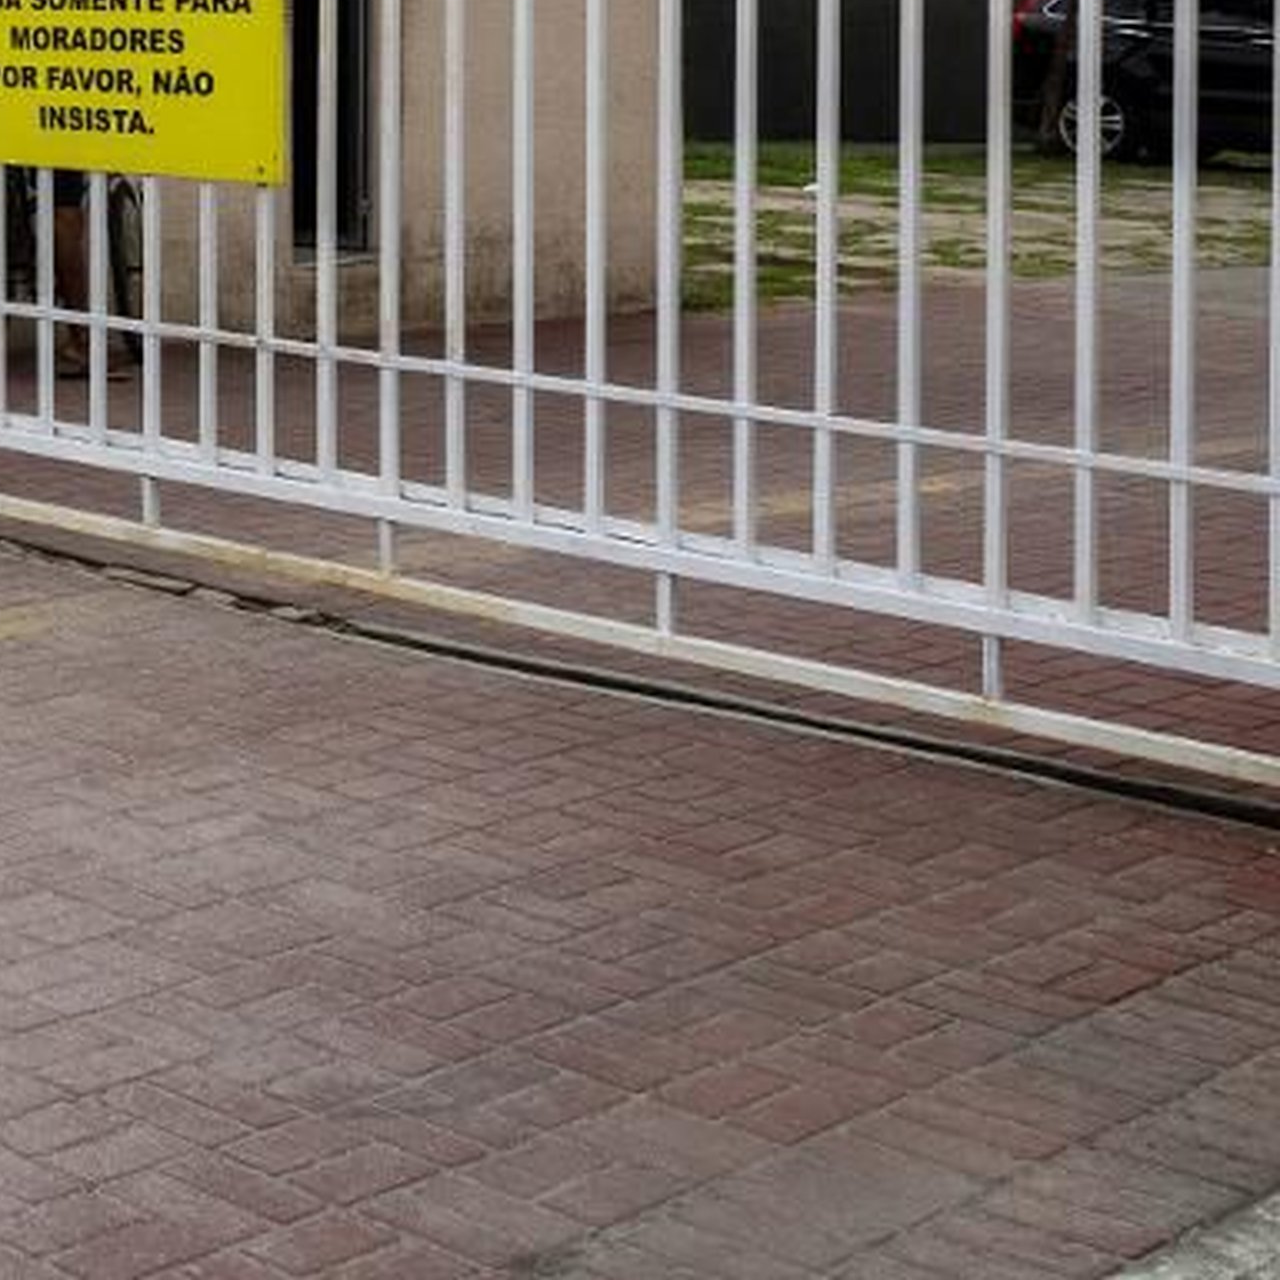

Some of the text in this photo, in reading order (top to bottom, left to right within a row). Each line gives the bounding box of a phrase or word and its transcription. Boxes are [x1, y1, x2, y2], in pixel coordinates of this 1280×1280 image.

[10, 25, 185, 54] MORADORES
[47, 66, 142, 98] FAVOR,
[153, 66, 215, 96] NÃO
[39, 105, 155, 135] INSISTA.
